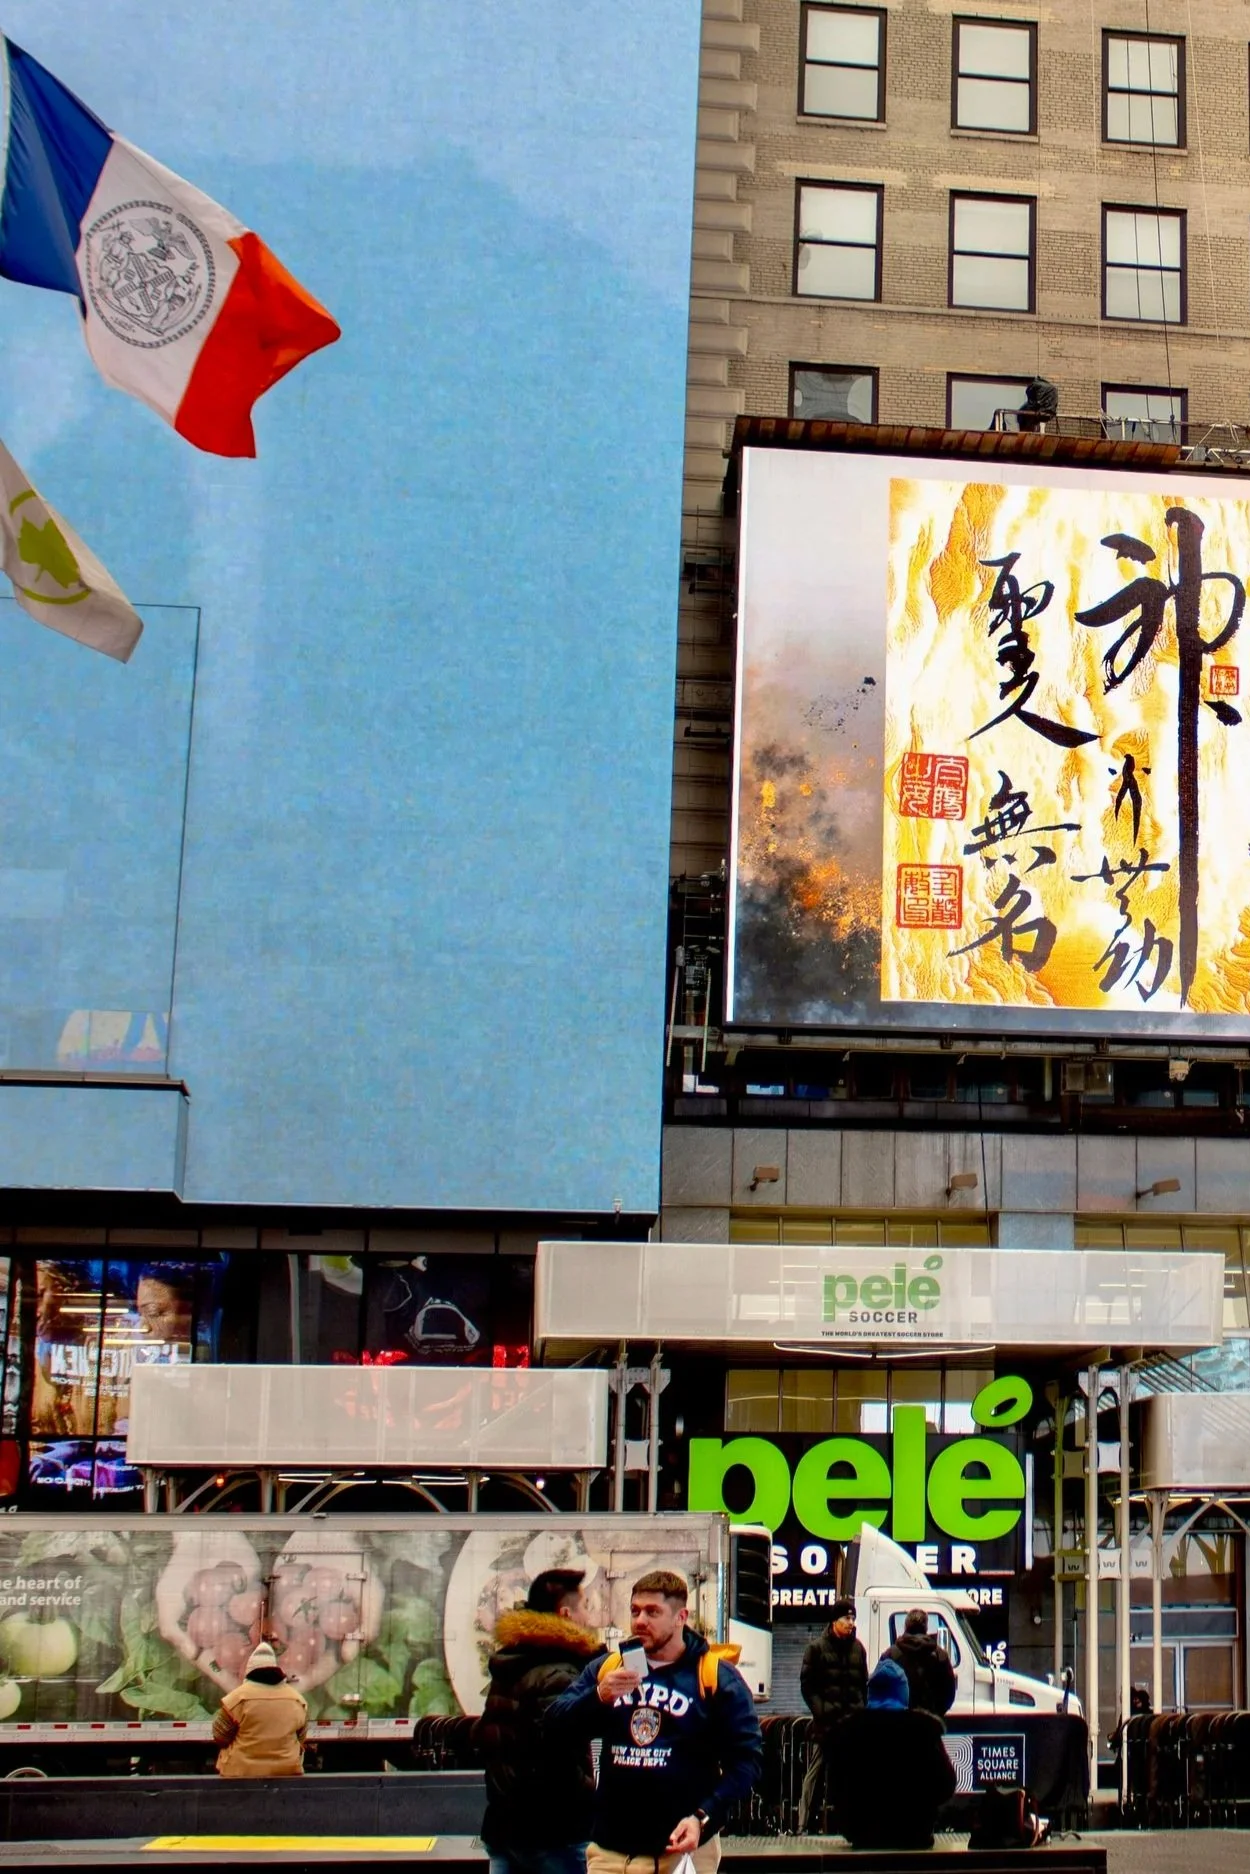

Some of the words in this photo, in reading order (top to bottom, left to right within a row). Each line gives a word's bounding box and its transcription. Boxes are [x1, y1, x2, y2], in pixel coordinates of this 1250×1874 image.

[824, 1254, 943, 1322] pelé
[849, 1311, 918, 1323] SOCCER
[688, 1375, 1033, 1544] pelé
[771, 1545, 977, 1574] SOER
[16, 1576, 60, 1590] heart
[64, 1576, 82, 1590] of
[30, 1592, 82, 1606] service
[611, 1745, 628, 1755] NEW
[629, 1747, 652, 1757] YORK
[652, 1748, 672, 1757] CITY
[981, 1746, 1016, 1758] TIMES
[613, 1756, 641, 1767] POLICE
[642, 1758, 667, 1767] DEPT.
[977, 1758, 1019, 1771] SQUARE
[980, 1771, 1017, 1780] ALLIANCE
